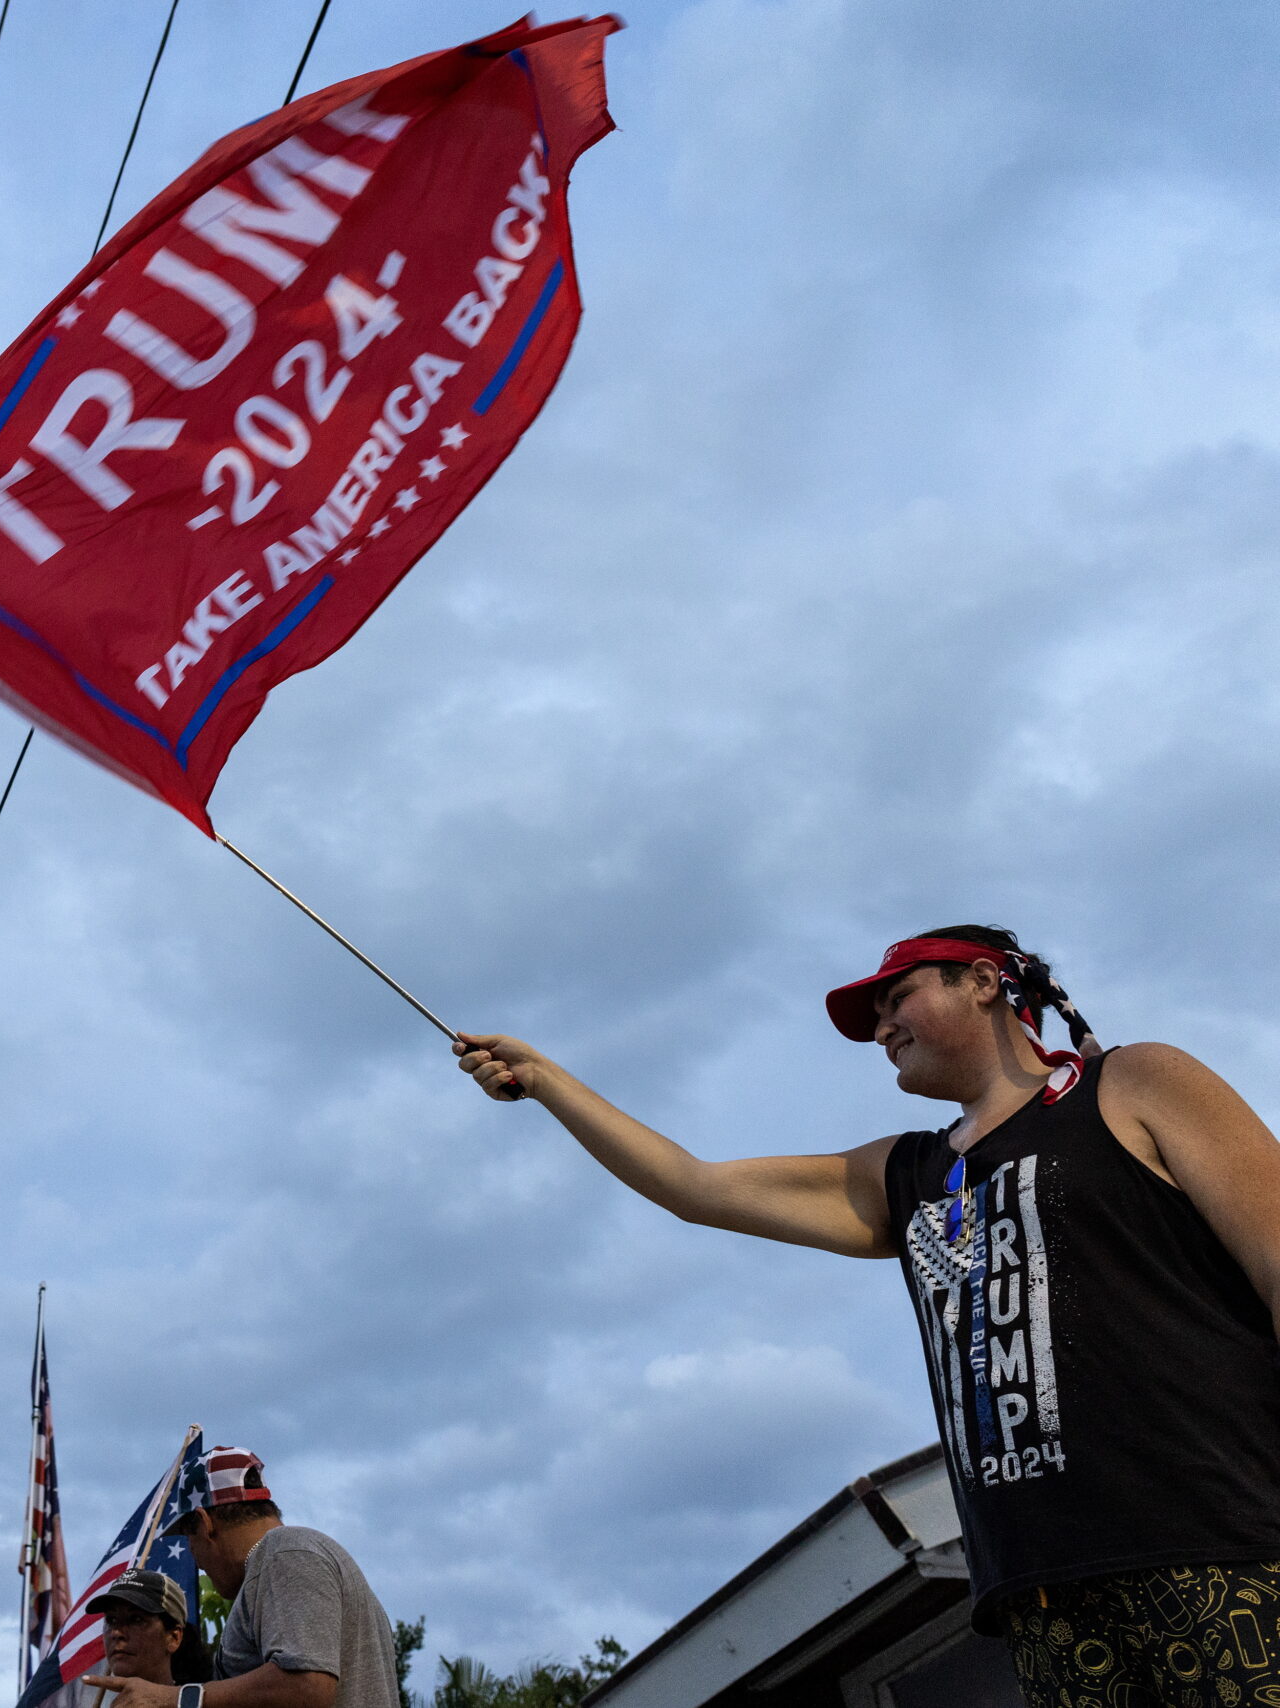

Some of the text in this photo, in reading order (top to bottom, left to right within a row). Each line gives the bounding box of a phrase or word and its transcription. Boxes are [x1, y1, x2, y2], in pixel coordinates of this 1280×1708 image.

[134, 150, 551, 711] TAKE AMERICA BACK
[969, 1216, 988, 1387] BACK THE BLUE
[990, 1160, 1029, 1451] TRUMP
[980, 1440, 1067, 1488] 2024
